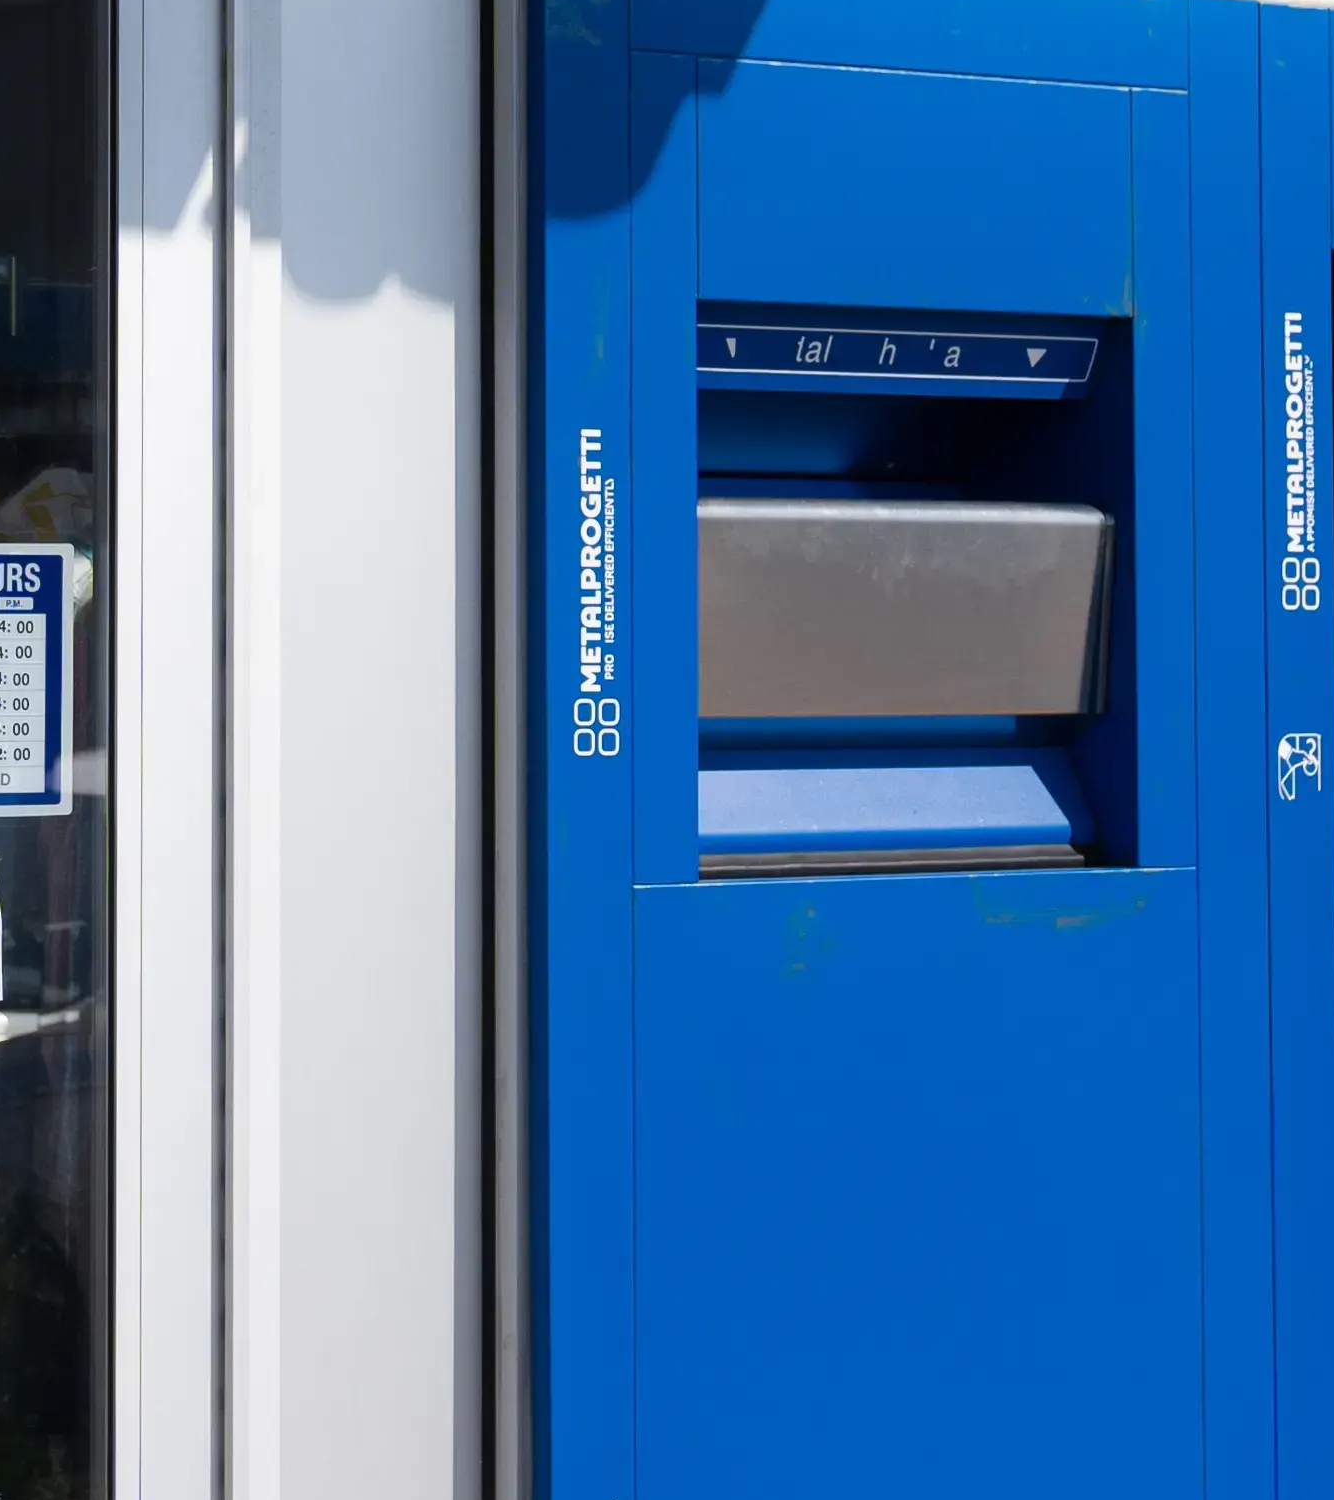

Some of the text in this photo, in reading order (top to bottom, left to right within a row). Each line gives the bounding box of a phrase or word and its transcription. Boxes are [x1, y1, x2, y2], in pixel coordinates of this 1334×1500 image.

[1284, 312, 1306, 552] METALPROGETTI
[1305, 427, 1315, 487] DELIVERED
[580, 429, 602, 692] METALPROGETTI
[604, 554, 615, 621] DELIVERED
[6, 600, 23, 608] P.M.
